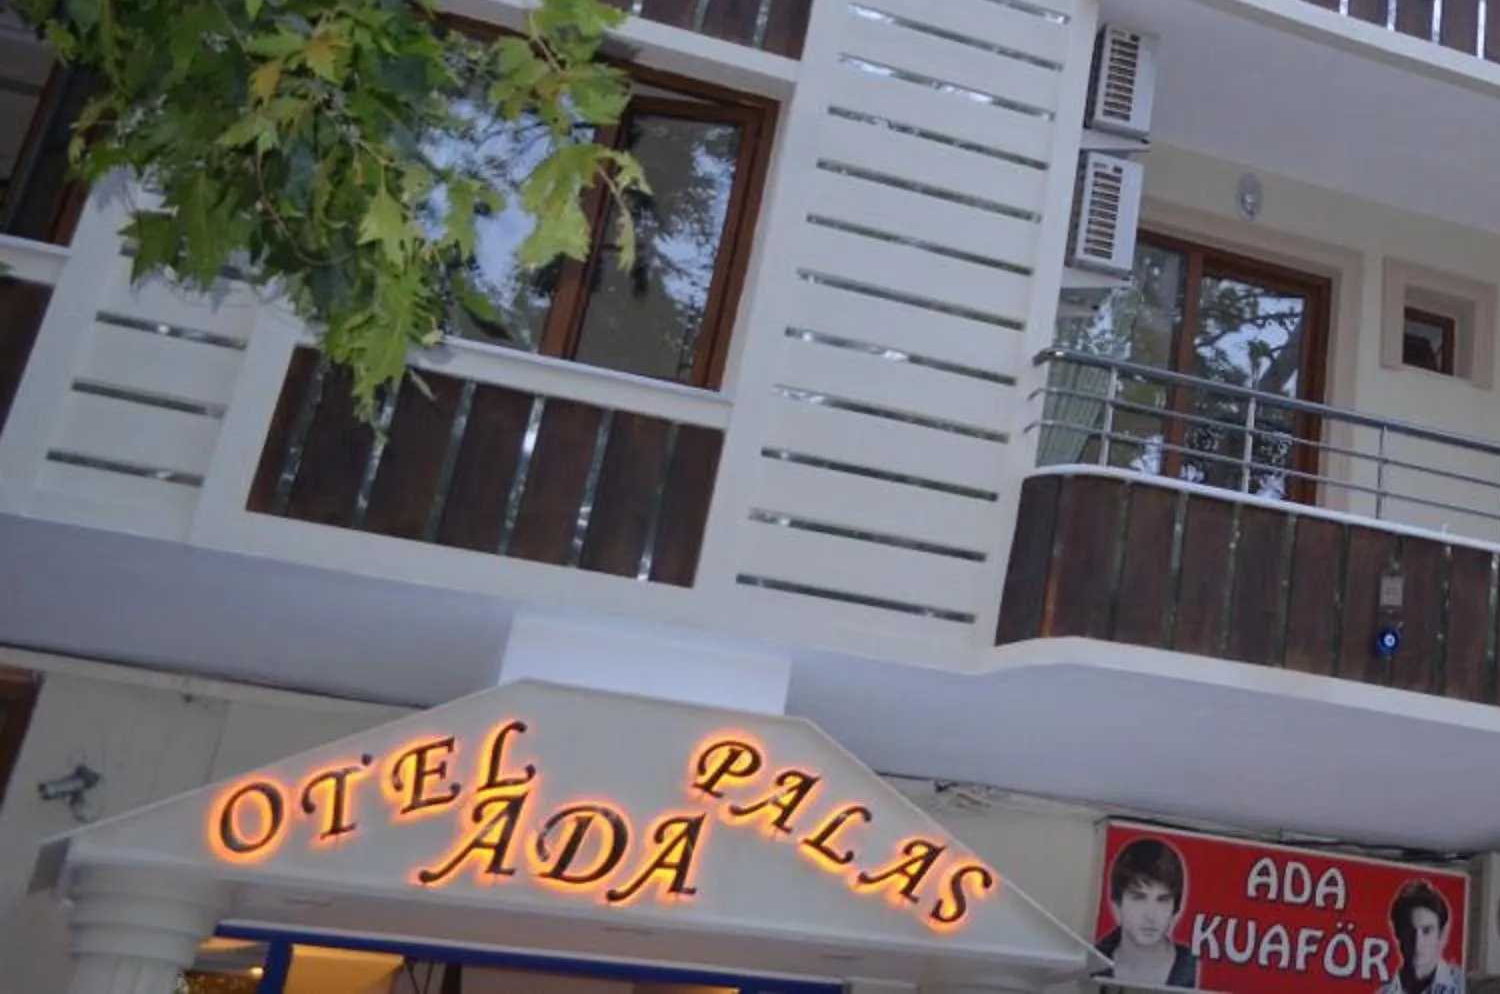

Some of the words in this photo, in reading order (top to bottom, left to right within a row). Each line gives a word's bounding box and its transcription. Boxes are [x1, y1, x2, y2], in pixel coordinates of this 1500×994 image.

[217, 720, 537, 854] OTEL
[418, 790, 710, 903] ADA
[695, 739, 993, 925] PALAS
[1247, 857, 1346, 910] ADA
[1190, 914, 1391, 981] KUAFÖR
